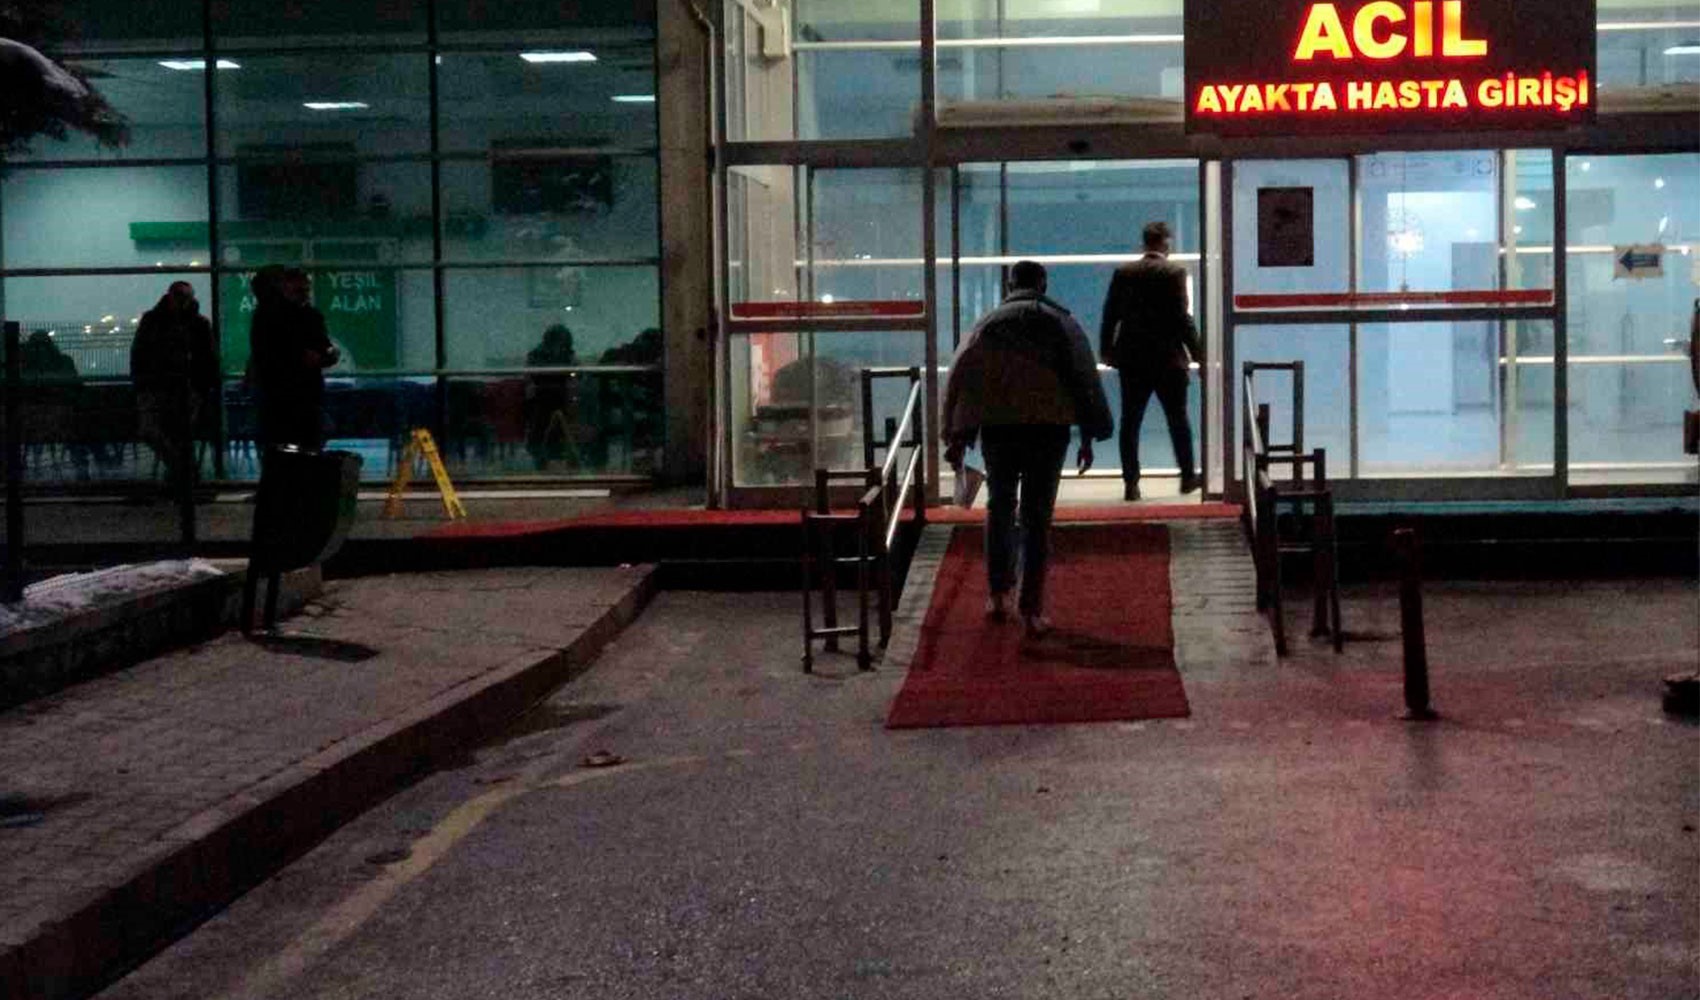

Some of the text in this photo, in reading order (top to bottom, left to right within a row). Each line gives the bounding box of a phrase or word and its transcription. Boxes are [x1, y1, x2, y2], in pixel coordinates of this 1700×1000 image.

[1196, 71, 1588, 113] AYAKTA HASTA GİRİŞİ
[329, 295, 382, 312] ALAN
